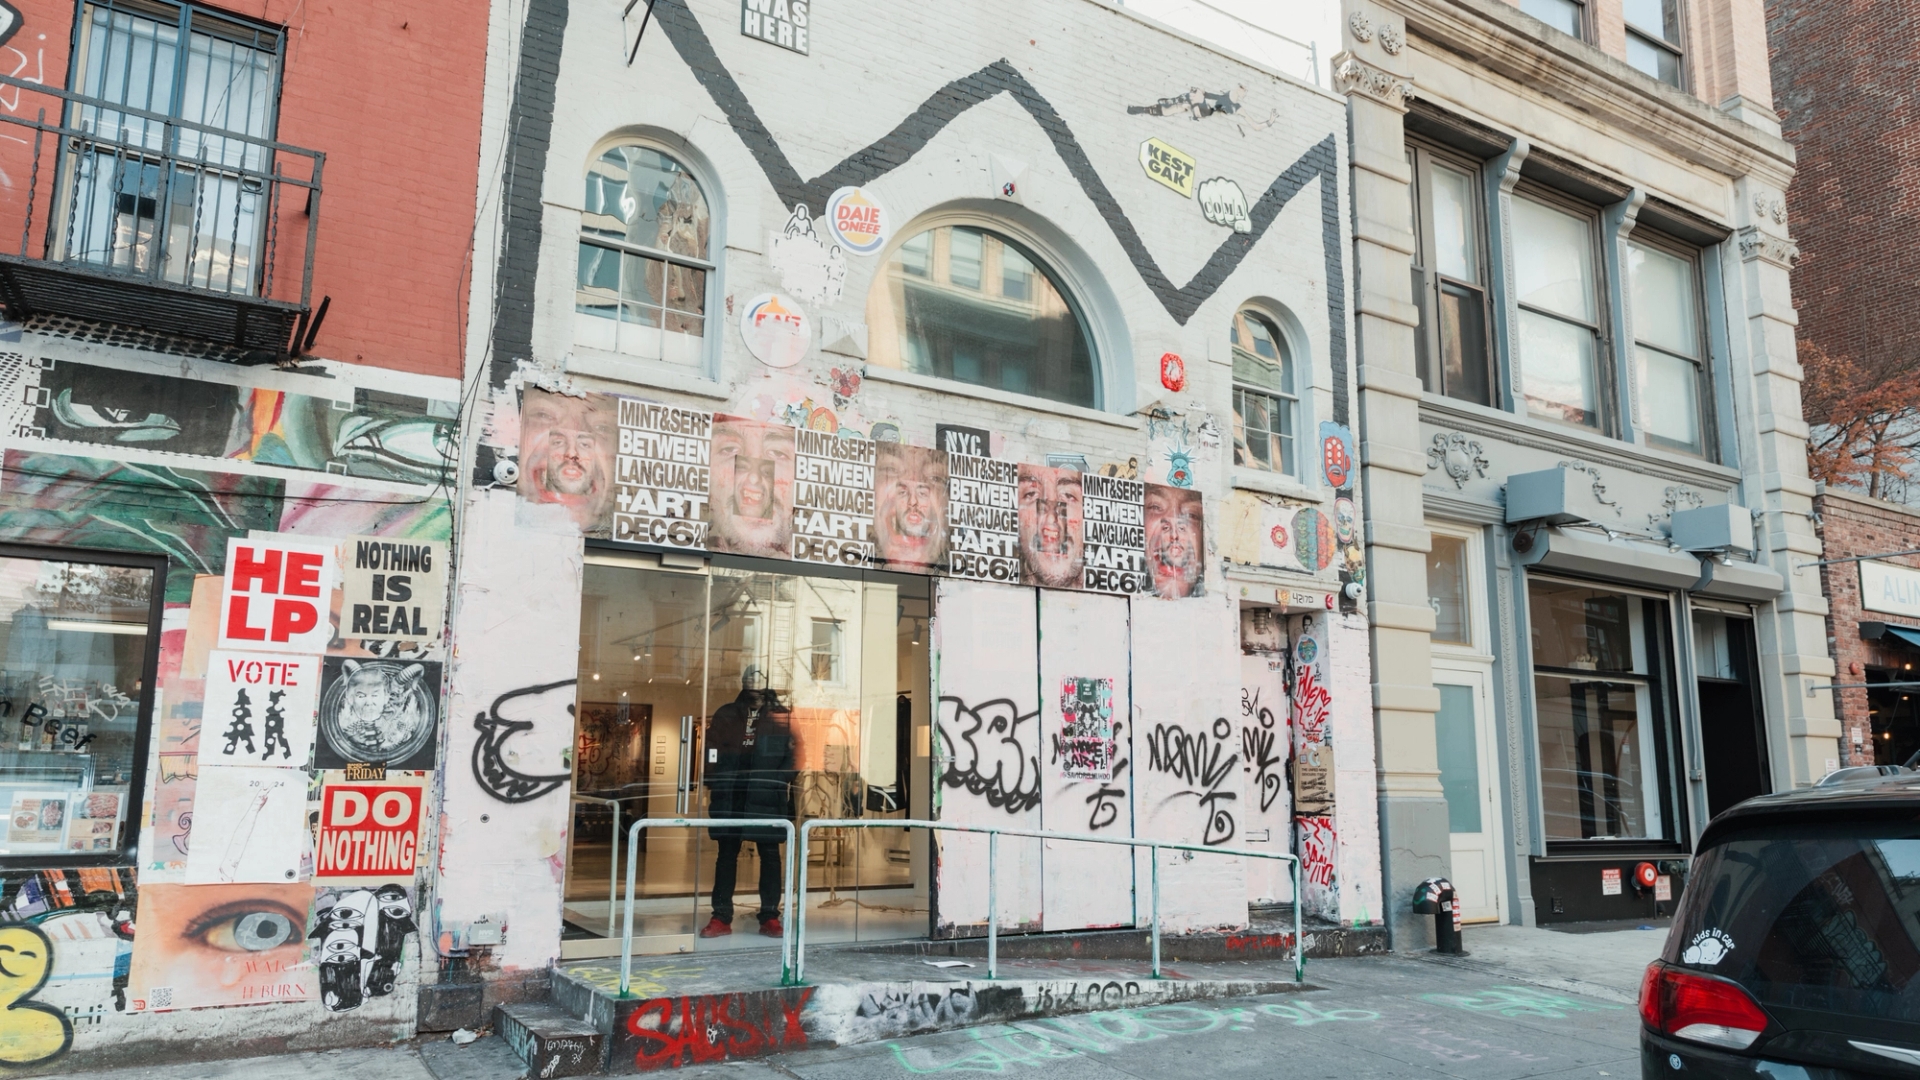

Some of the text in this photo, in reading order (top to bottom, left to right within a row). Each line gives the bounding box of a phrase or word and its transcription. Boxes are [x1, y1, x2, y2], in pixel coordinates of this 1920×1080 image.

[747, 0, 807, 27] WAS
[745, 9, 807, 53] HERE
[1148, 143, 1194, 177] KEST
[1148, 159, 1186, 188] GAK
[837, 205, 880, 223] DAIE
[1204, 201, 1244, 217] COMA
[838, 220, 881, 235] ONEEE
[620, 400, 711, 438] MINT&SERF
[619, 428, 711, 465] BETWEEN
[797, 430, 875, 463] MINT&SERF
[945, 430, 982, 457] NYC
[617, 457, 709, 492] LANGUAGE
[796, 455, 875, 490] BETWEEN
[950, 454, 1018, 484] MINT&SERF
[795, 482, 874, 515] LANGUAGE
[950, 478, 1018, 509] BETWEEN
[1083, 475, 1143, 502] MINT&SERF
[950, 503, 1018, 533] LANGUAGE
[1083, 497, 1144, 526] BETWEEN
[1084, 521, 1144, 548] LANGUAGE
[355, 540, 432, 573] NOTHING
[231, 546, 324, 598] HE
[371, 574, 412, 602] IS
[226, 595, 319, 643] LP
[351, 604, 428, 636] REAL
[227, 659, 300, 687] VOTE
[20, 703, 98, 751] Beef
[346, 765, 386, 781] FRIDAY
[331, 790, 412, 827] DO
[320, 830, 415, 871] NOTHING
[1711, 927, 1722, 938] in
[261, 983, 309, 998] BURN
